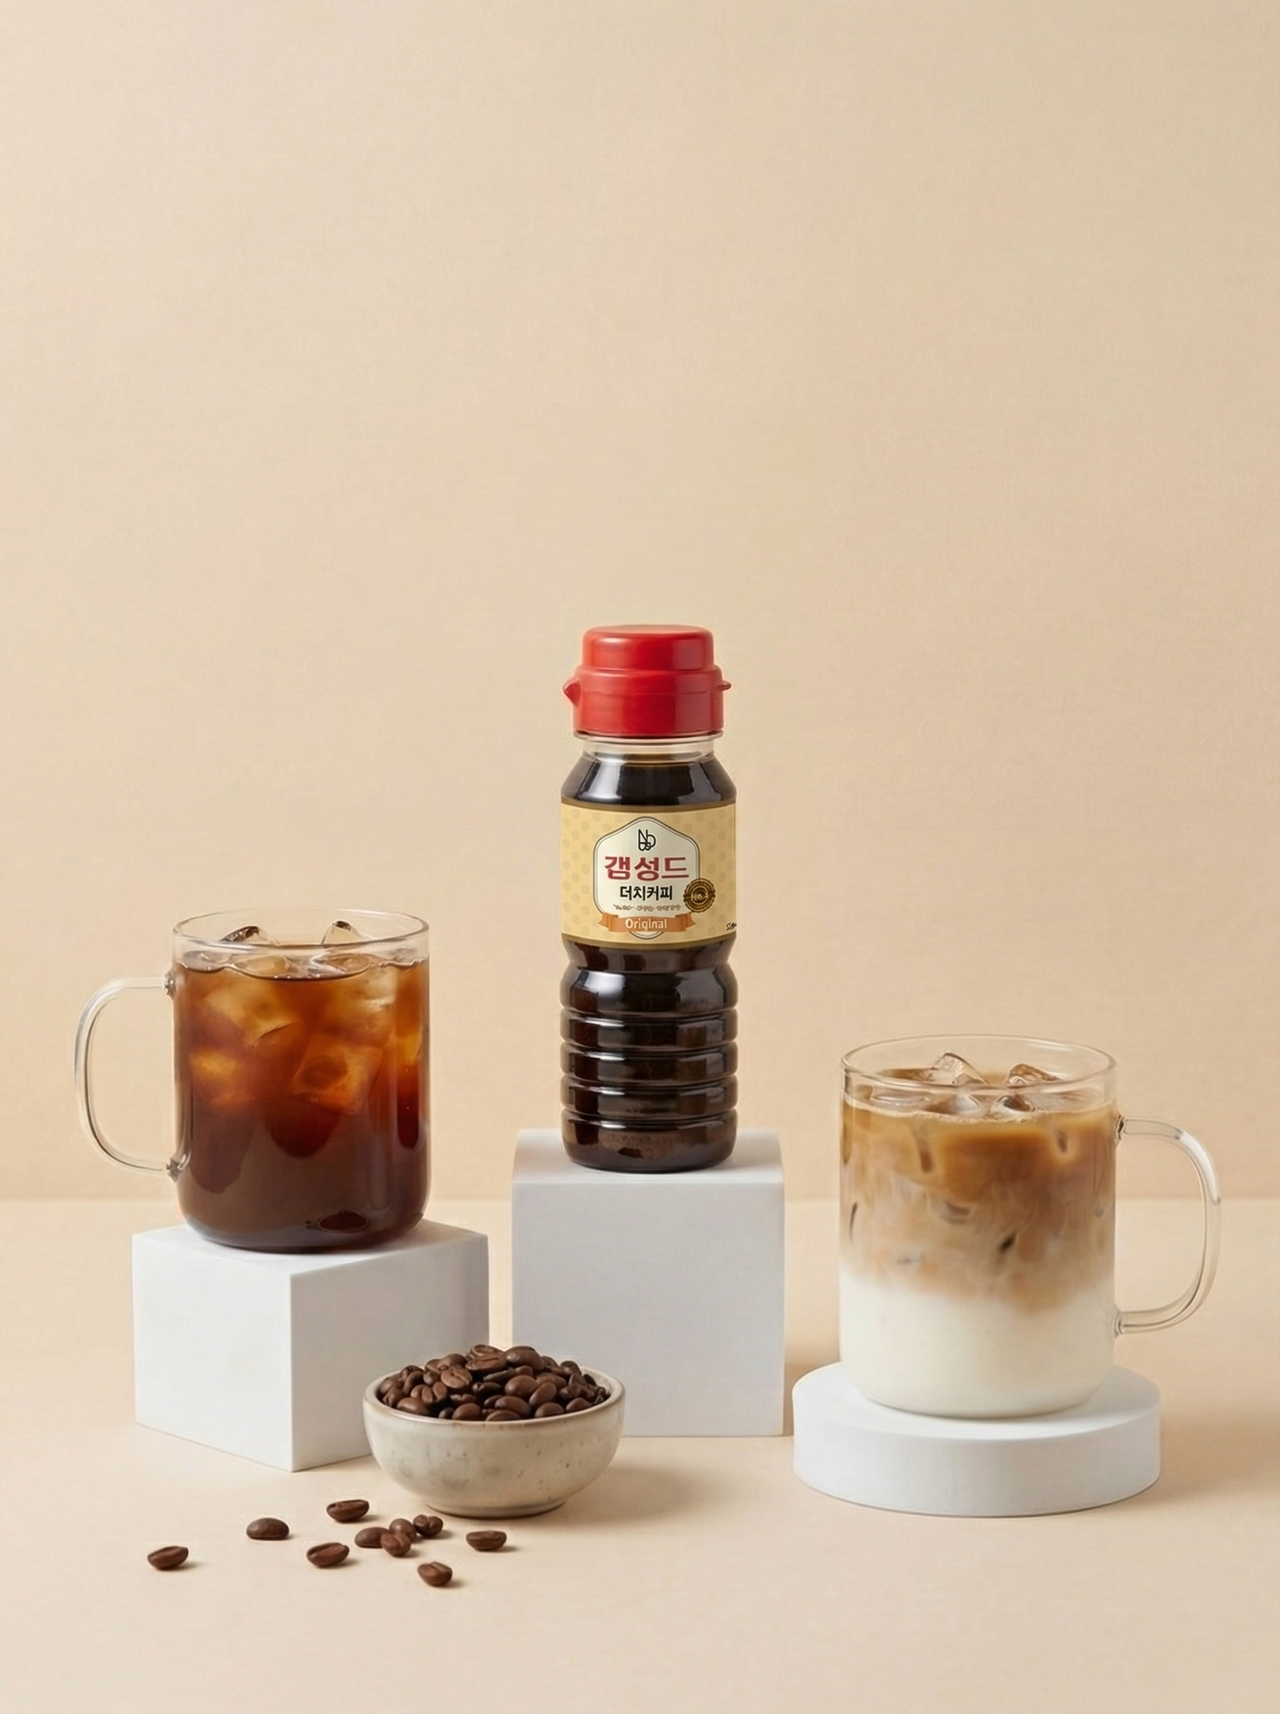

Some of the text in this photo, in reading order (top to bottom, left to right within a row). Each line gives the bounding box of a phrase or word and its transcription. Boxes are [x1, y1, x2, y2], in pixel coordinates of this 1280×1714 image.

[604, 856, 690, 881] 갬성드
[620, 885, 673, 901] 더치커피
[625, 918, 667, 931] Original
